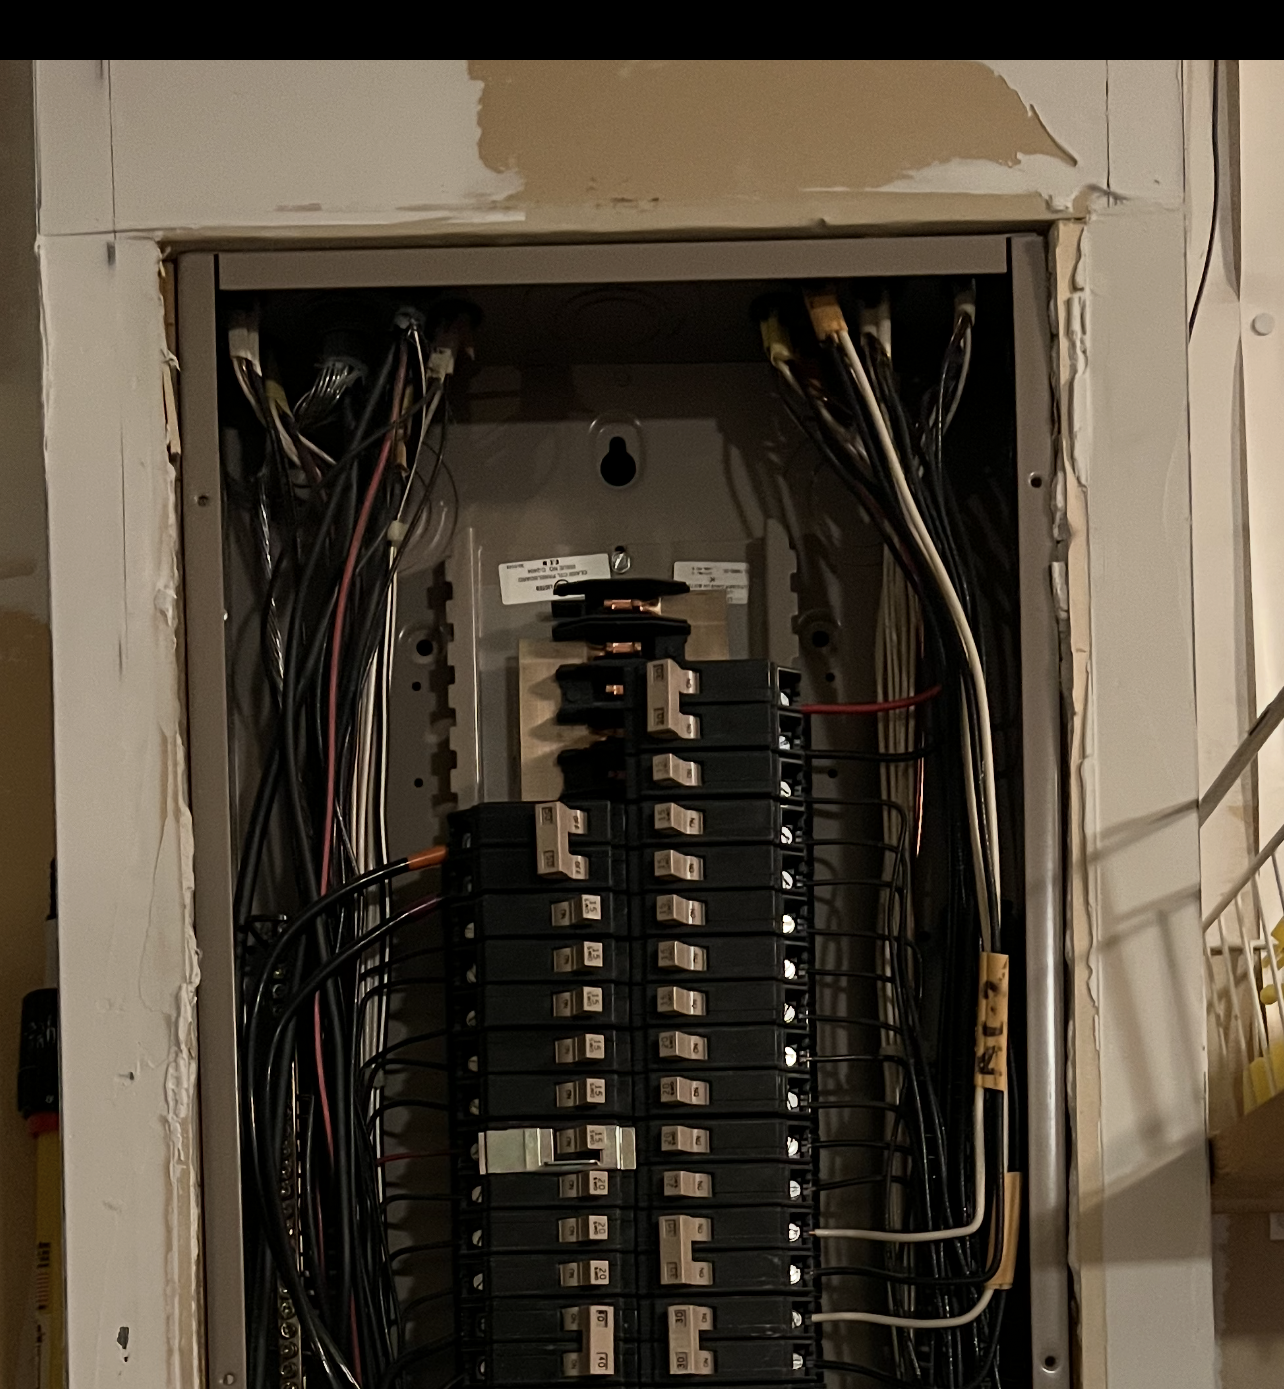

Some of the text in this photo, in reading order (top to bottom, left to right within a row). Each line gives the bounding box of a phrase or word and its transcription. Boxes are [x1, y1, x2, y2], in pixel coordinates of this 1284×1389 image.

[593, 949, 600, 960] 15
[592, 993, 599, 1005] 15
[594, 1040, 601, 1051] 15
[595, 1085, 603, 1097] 15
[662, 1083, 670, 1095] 20
[595, 1132, 603, 1143] 15
[664, 1132, 672, 1145] 20
[598, 1178, 606, 1190] 20
[598, 1222, 606, 1234] 20
[599, 1268, 607, 1280] 20
[676, 1312, 683, 1323] 30
[598, 1356, 606, 1368] 40
[677, 1357, 685, 1368] 30
